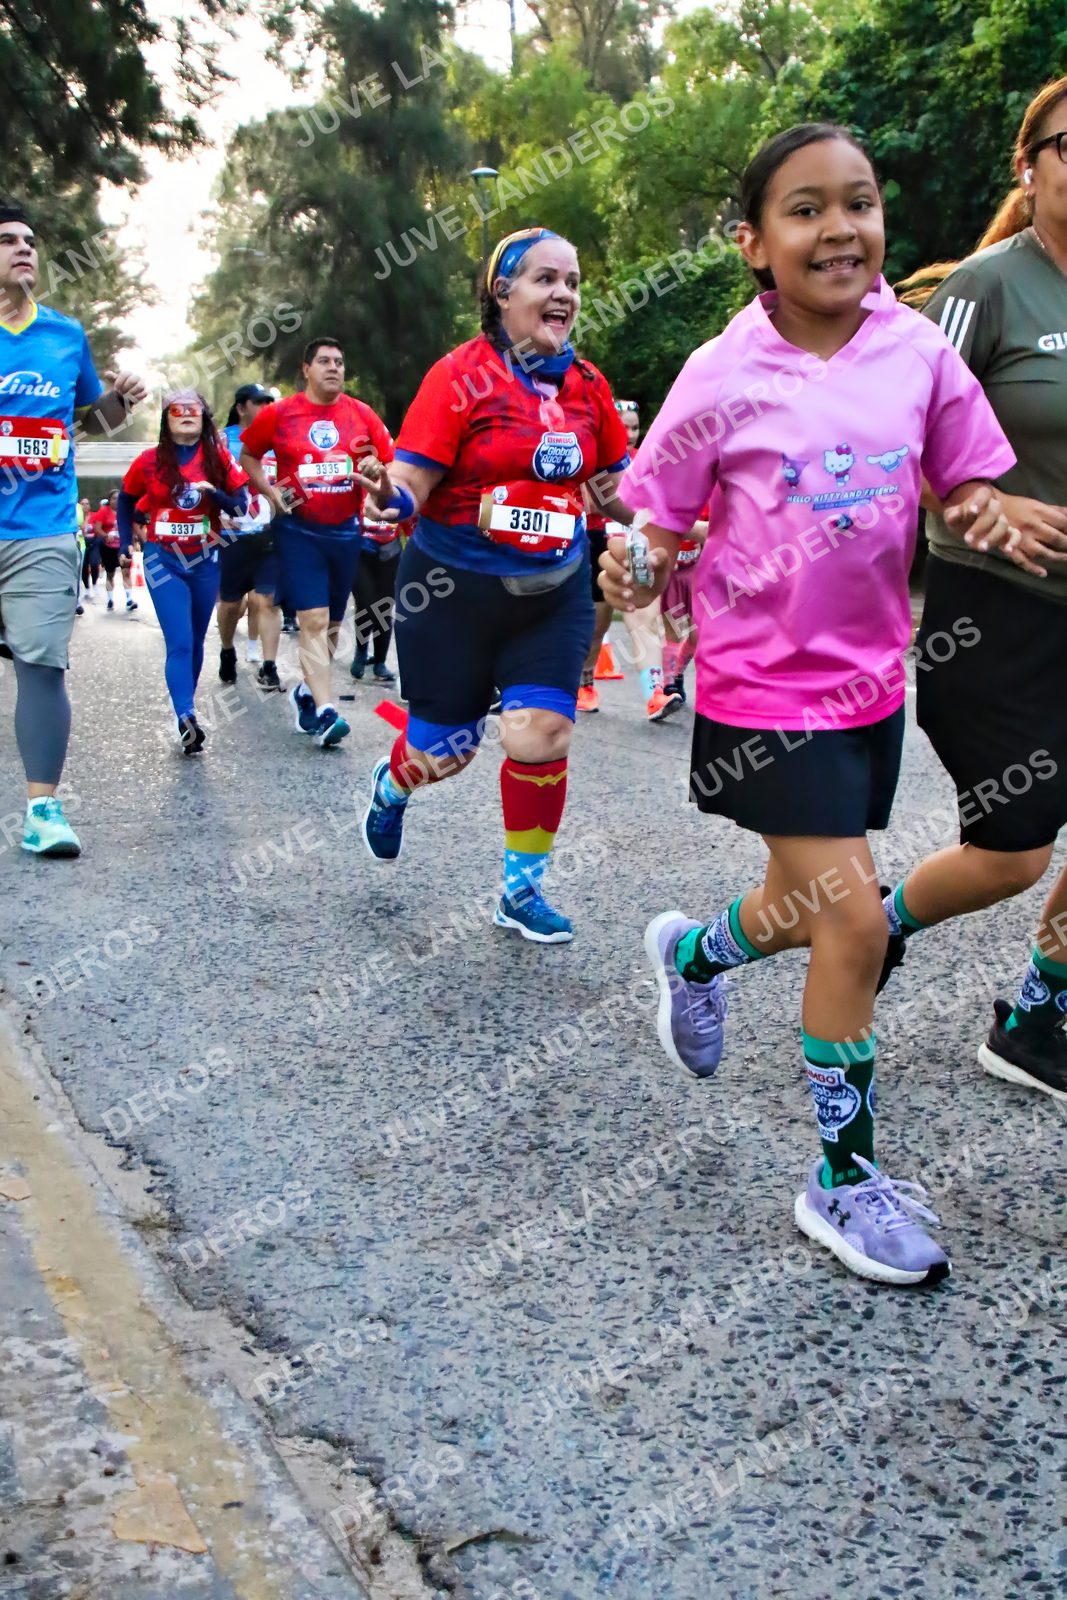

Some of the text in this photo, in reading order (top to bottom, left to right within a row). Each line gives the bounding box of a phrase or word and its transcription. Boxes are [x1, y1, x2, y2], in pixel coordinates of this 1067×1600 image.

[17, 438, 49, 456] 1583
[315, 463, 340, 475] 3335
[786, 495, 811, 504] HELLO
[813, 491, 840, 502] KITTY
[843, 488, 861, 498] AND
[509, 508, 551, 534] 3301
[171, 524, 195, 535] 3337
